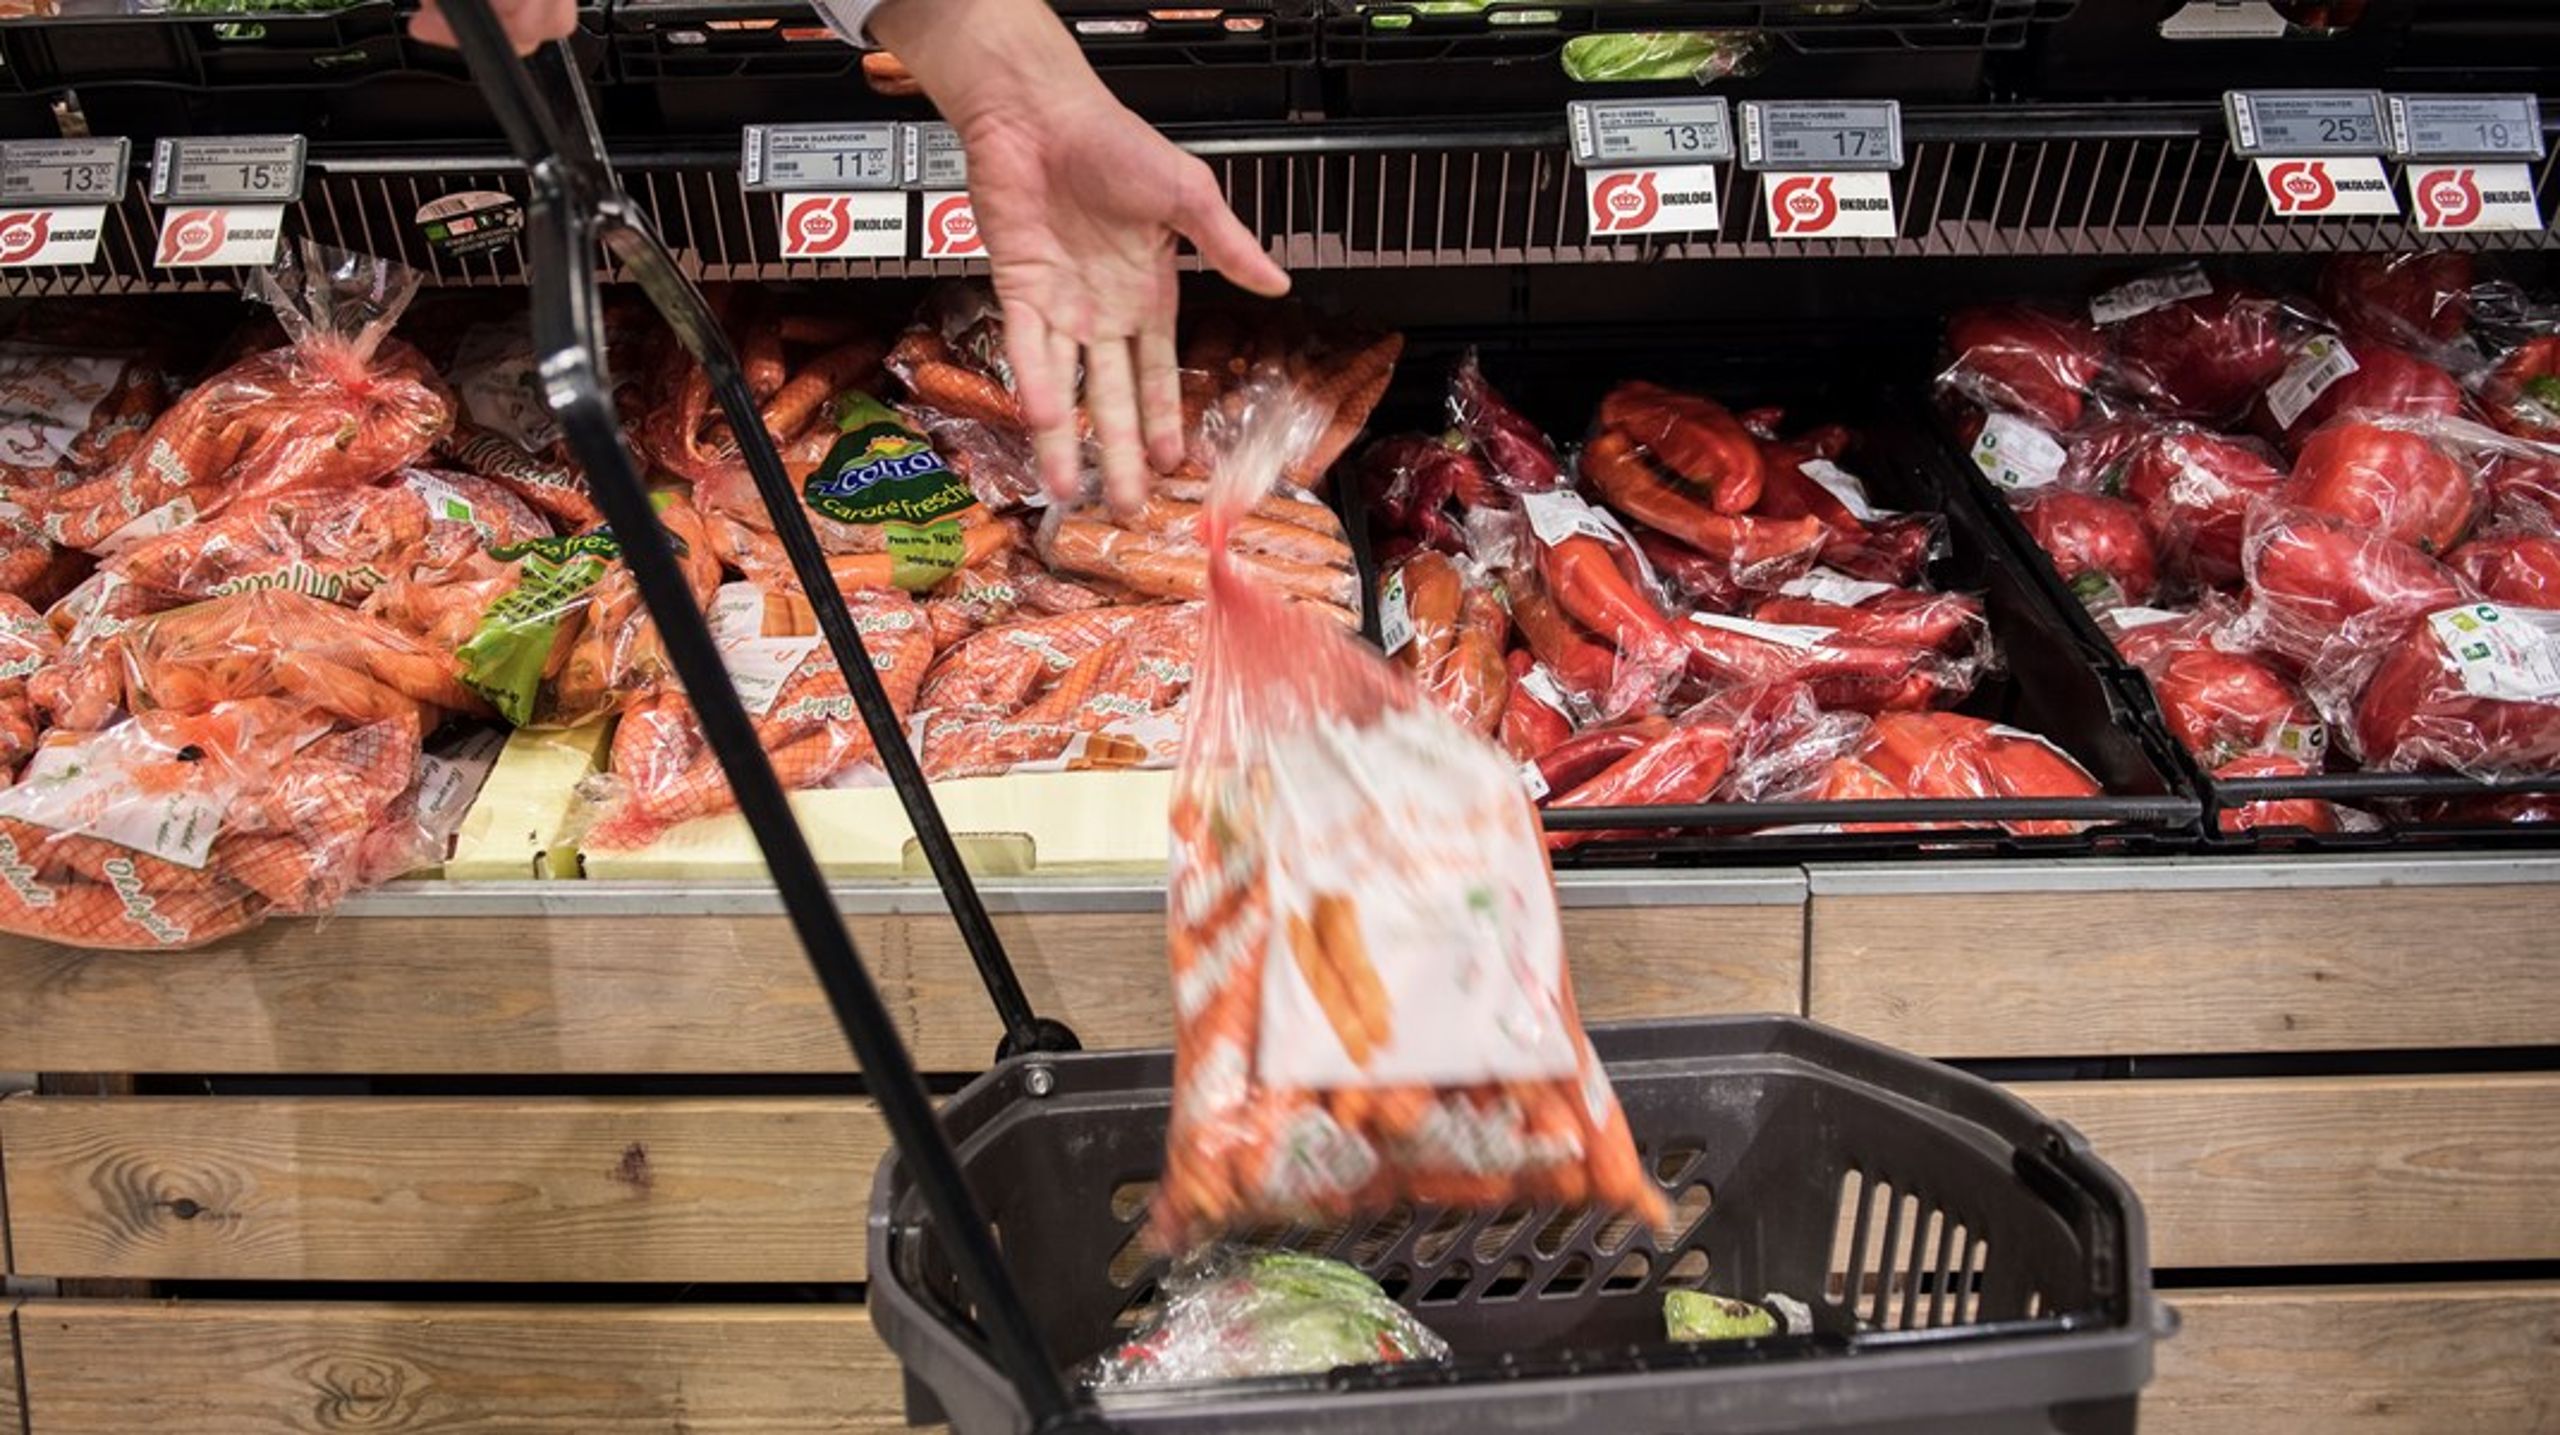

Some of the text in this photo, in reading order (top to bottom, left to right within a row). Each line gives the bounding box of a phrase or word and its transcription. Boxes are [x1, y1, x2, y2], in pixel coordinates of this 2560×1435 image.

[1664, 125, 1700, 150] 13
[2319, 118, 2358, 142] 25
[2475, 123, 2509, 148] 19
[1832, 130, 1866, 157] 17
[832, 151, 863, 177] 11
[62, 166, 93, 191] 13
[239, 164, 270, 190] 15
[2334, 179, 2386, 191] ØKOLOGI
[1661, 192, 1713, 206] ØKOLOGI
[1839, 198, 1889, 211] ØKOLOGI
[2482, 191, 2532, 204] ØKOLOGI
[49, 229, 97, 243] ØKOLOGI
[226, 229, 276, 242] ØKOLOGI
[853, 218, 903, 232] ØKOLOGI
[822, 498, 900, 520] carote
